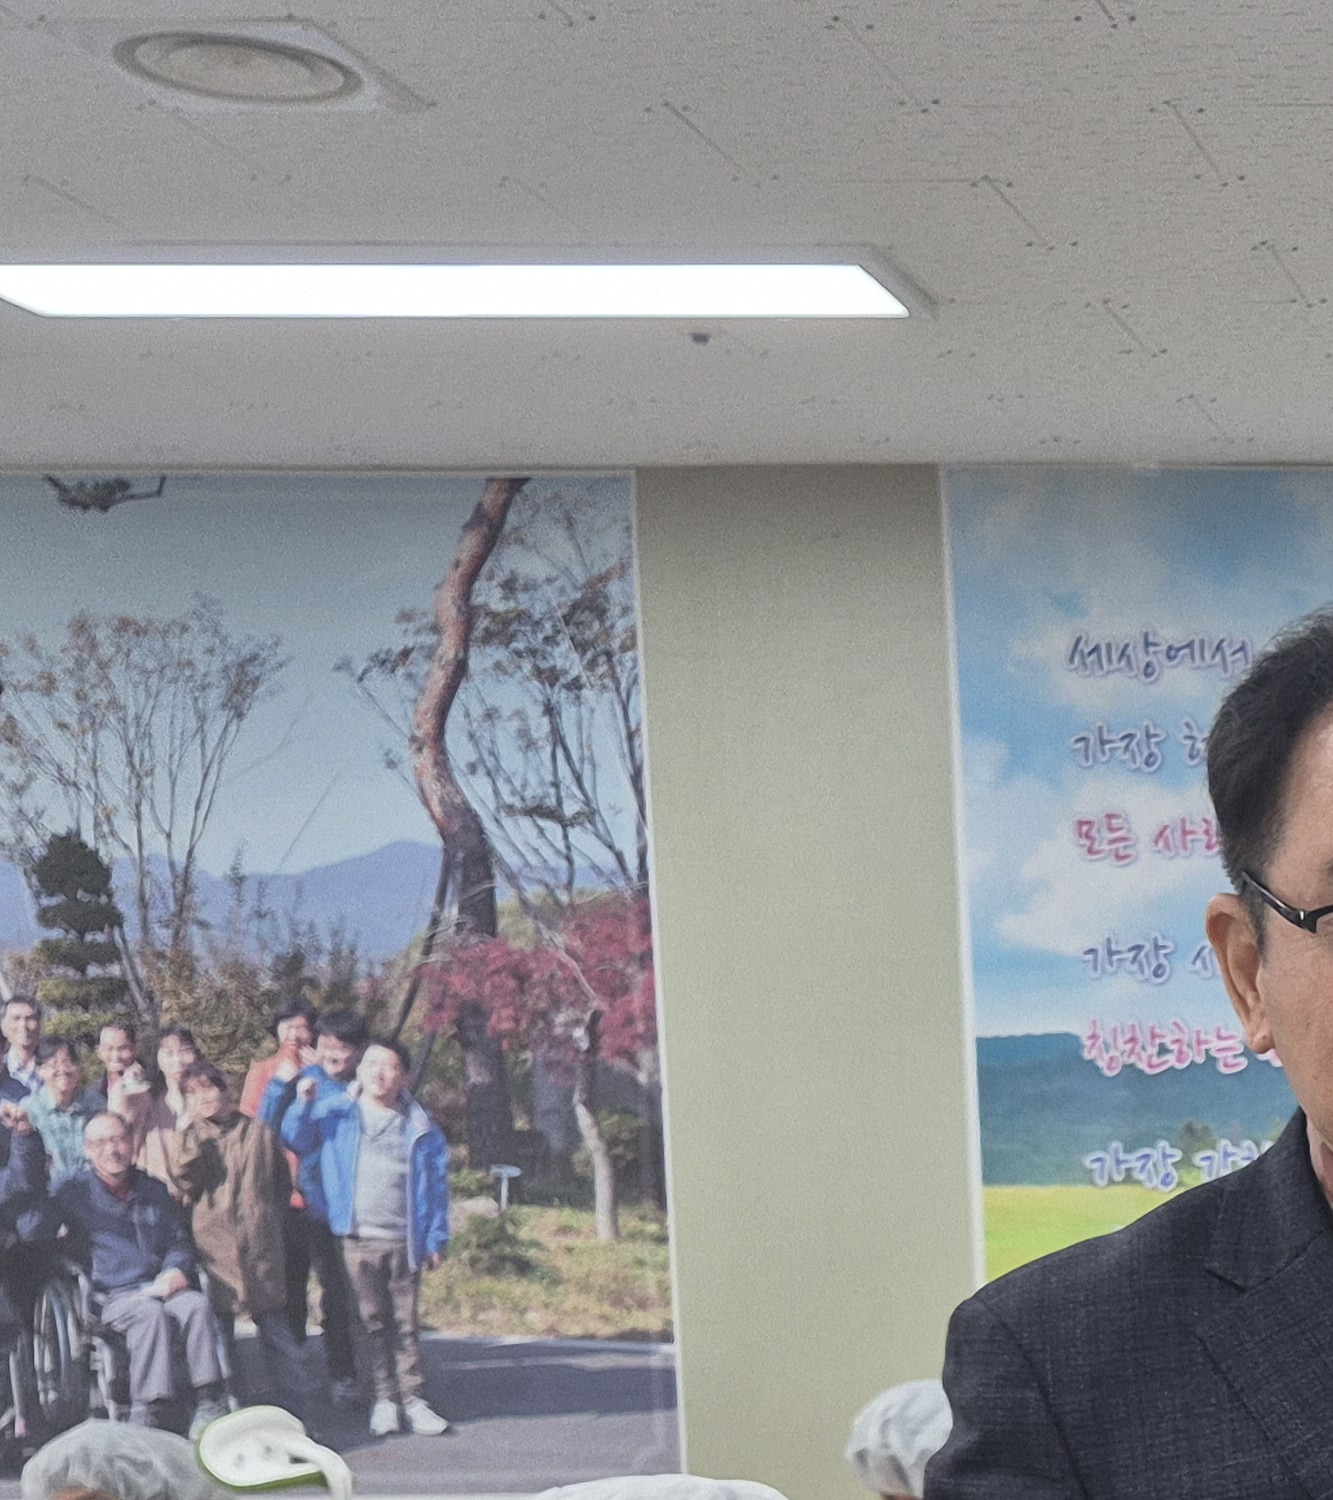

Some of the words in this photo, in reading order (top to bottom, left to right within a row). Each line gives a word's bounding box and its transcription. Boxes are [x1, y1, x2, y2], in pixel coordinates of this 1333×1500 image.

[1068, 630, 1249, 680] 세상에서
[1073, 722, 1165, 770] 가장
[1077, 812, 1133, 864] 모든
[1082, 934, 1172, 982] 가장
[1084, 1018, 1248, 1074] 칭찬하는
[1089, 1142, 1181, 1189] 가장
